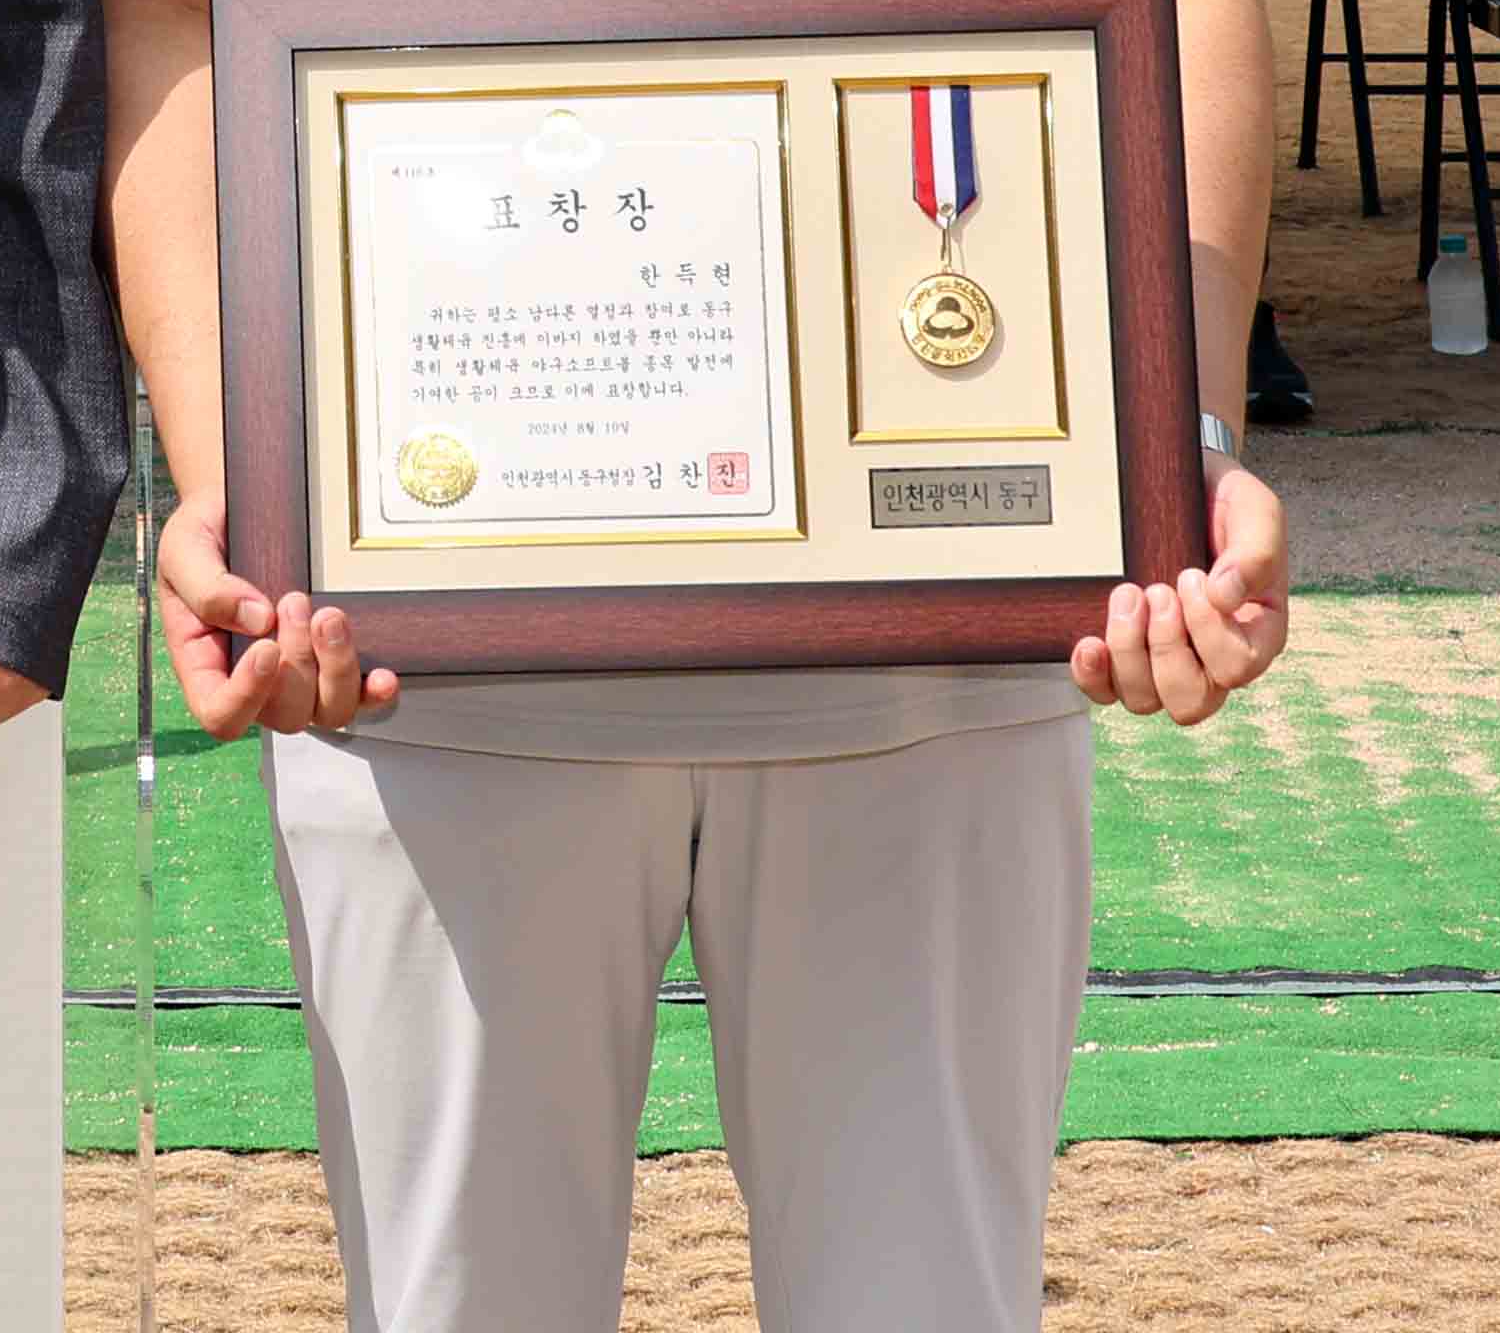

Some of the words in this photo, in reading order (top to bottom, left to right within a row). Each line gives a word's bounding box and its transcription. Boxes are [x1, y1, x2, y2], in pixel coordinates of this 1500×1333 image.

[702, 300, 733, 318] 동구
[687, 327, 733, 342] 아니라
[883, 482, 989, 512] 인천광역시
[999, 480, 1039, 511] 동구
